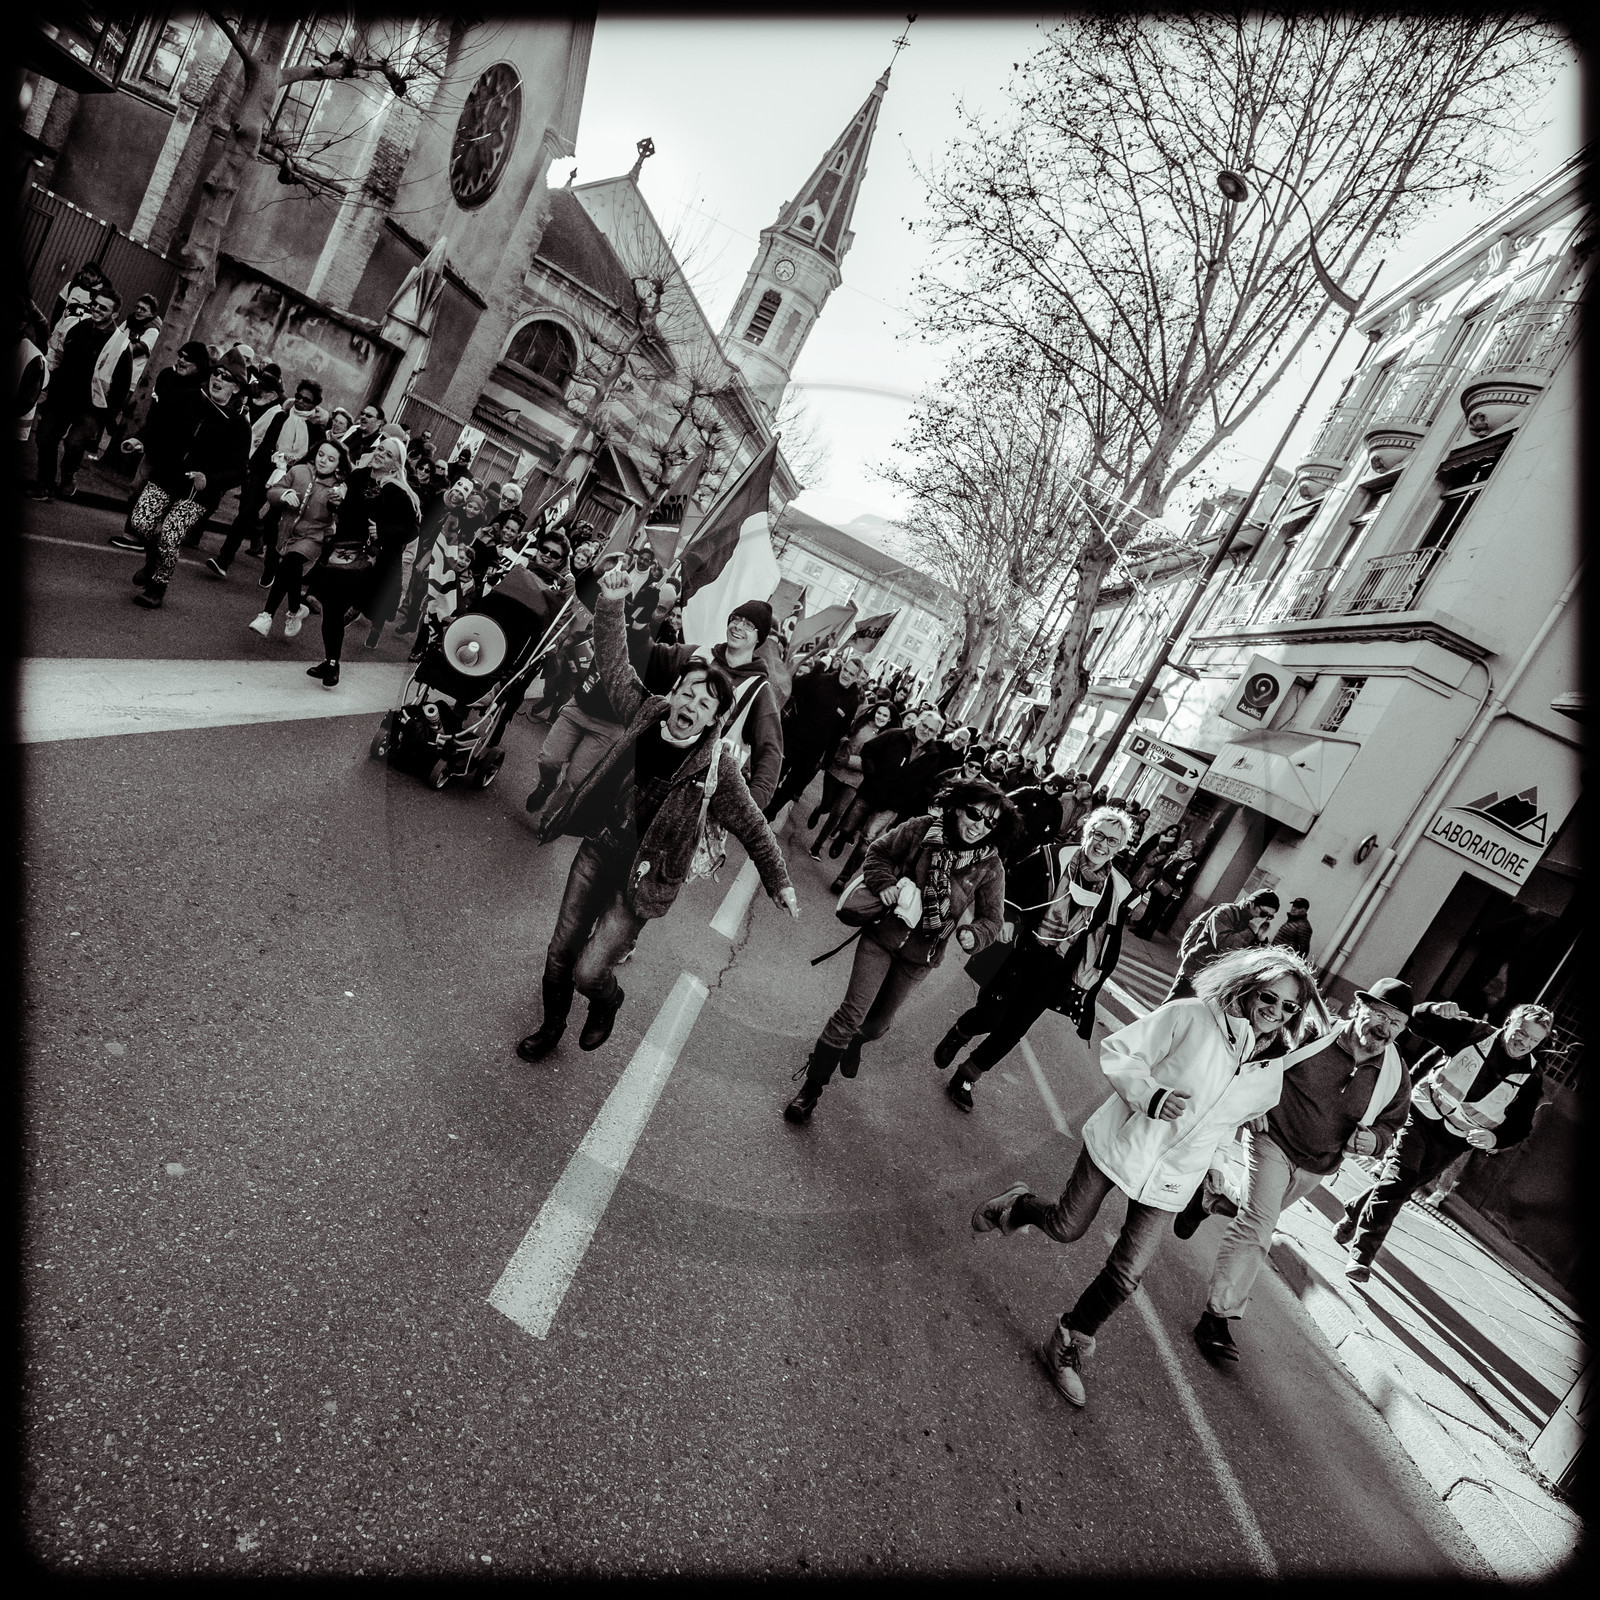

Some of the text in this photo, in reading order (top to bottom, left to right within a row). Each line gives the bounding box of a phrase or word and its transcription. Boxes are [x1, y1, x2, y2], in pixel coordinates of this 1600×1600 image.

[1133, 739, 1176, 760] P BONNE
[1159, 798, 1182, 814] ESSAI
[1431, 815, 1529, 877] LABORATOIRE
